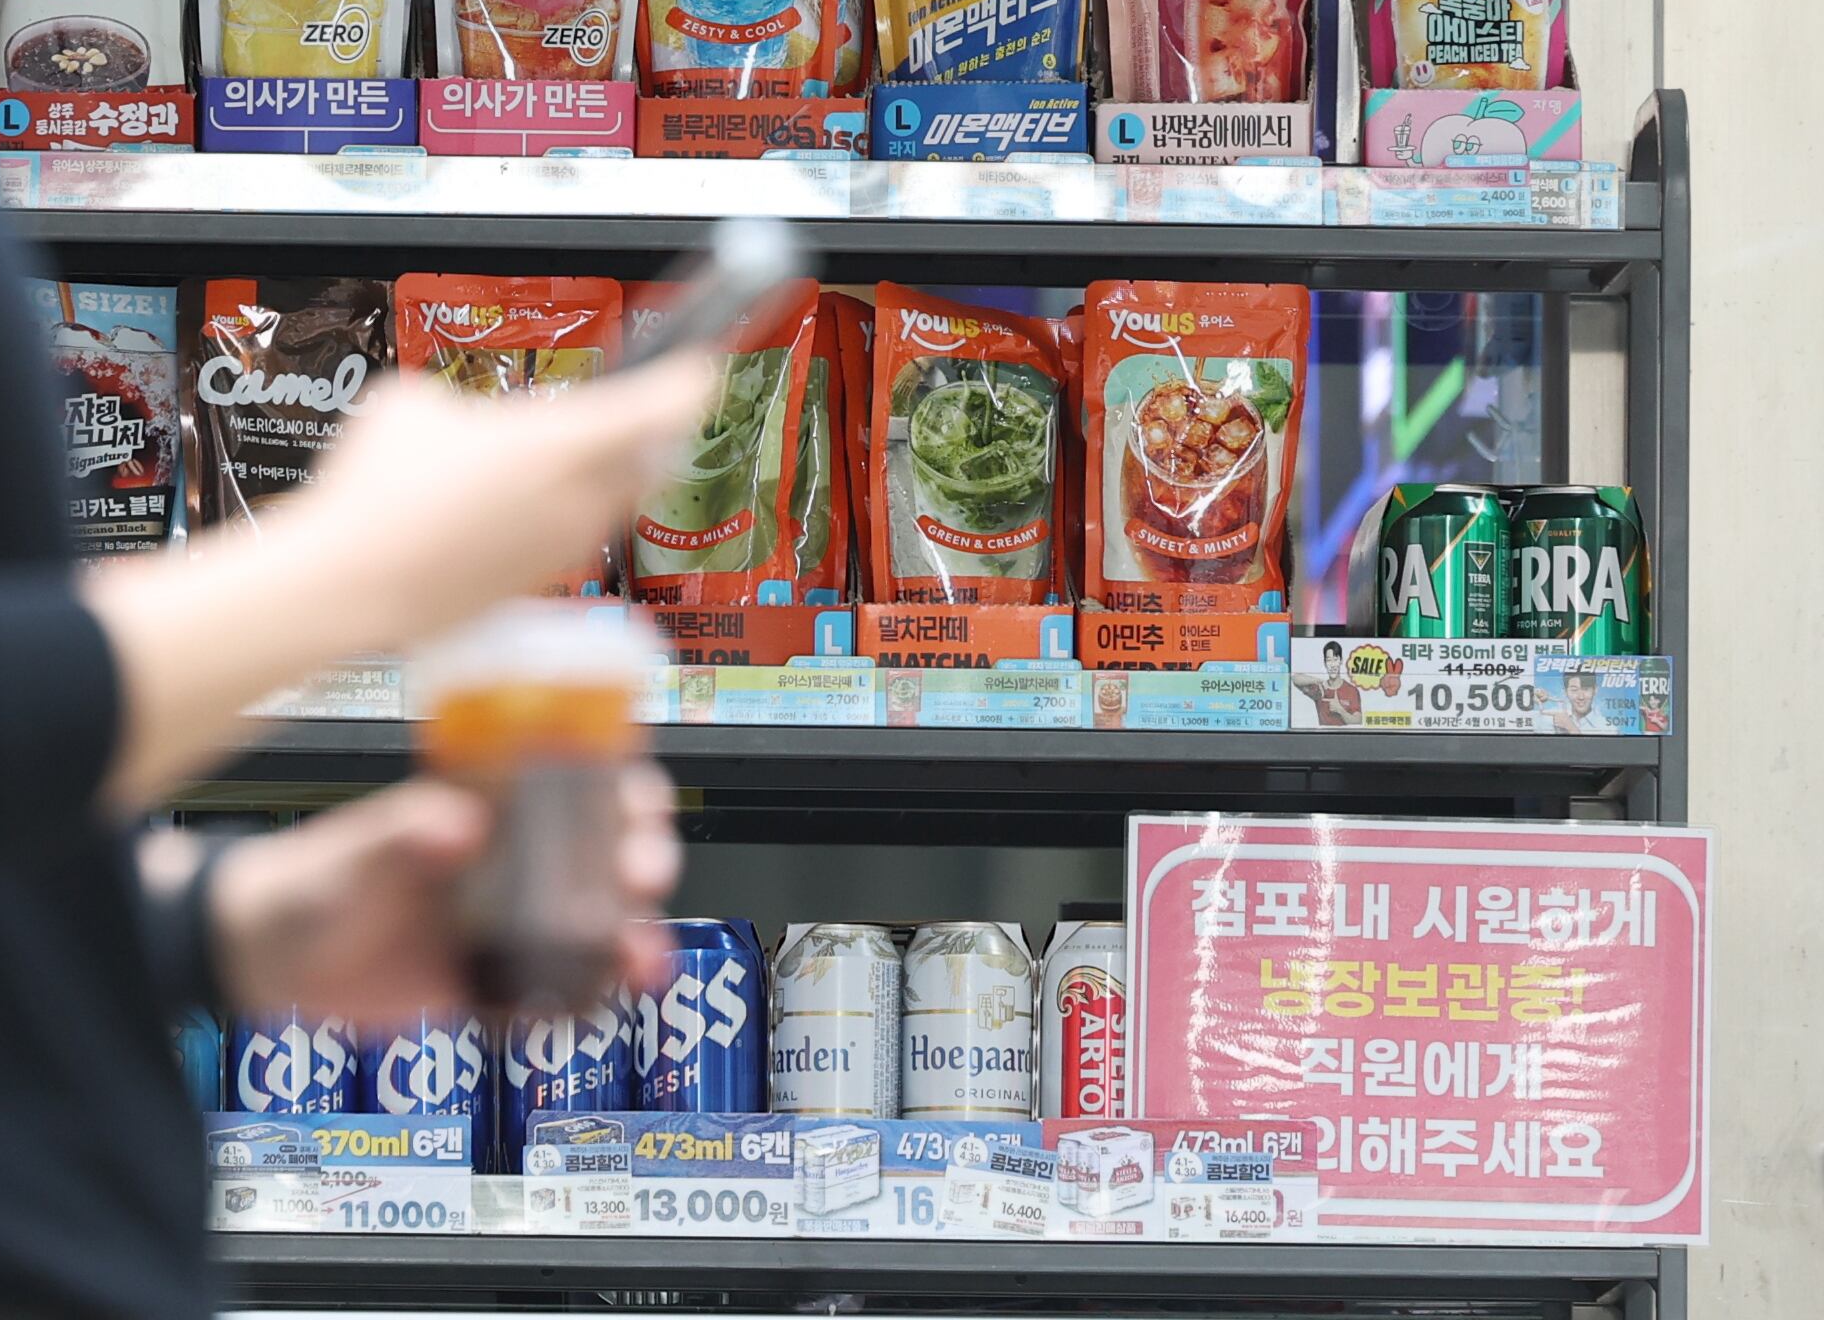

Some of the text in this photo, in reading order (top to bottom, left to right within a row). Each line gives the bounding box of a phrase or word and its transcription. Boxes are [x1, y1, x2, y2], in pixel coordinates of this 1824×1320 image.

[304, 23, 364, 45] ZERO
[681, 18, 785, 40] ZESTY & COOL
[1427, 14, 1523, 44] 아이스티
[1427, 43, 1523, 64] PEACH ICED TEA
[224, 79, 390, 115] 의사가 만든
[442, 82, 606, 119] 의사가 만든
[4, 105, 20, 130] L
[48, 102, 179, 137] 상주 수정과
[888, 140, 917, 157] 라지
[1480, 191, 1516, 204] 2,400
[1109, 308, 1235, 339] youus 유어스
[198, 353, 379, 418] Camel
[644, 518, 741, 547] SWEET & MILKY
[927, 524, 1039, 549] GREEN & CREAMY
[1138, 529, 1250, 554] SWEET & MINTY
[879, 615, 968, 643] 말차라떼
[1097, 623, 1221, 652] 아민추 아이스티
[1351, 655, 1384, 675] SALE
[1402, 643, 1433, 660] 테라
[1439, 645, 1496, 660] 360ml
[1501, 645, 1528, 661] 6입
[1601, 673, 1637, 688] 100%
[1238, 699, 1273, 712] 2,200
[1407, 683, 1536, 717] 10,500
[1605, 698, 1636, 710] TERRA
[1605, 716, 1637, 727] SON7
[1333, 882, 1390, 941] 내
[1412, 884, 1657, 947] 시원하게
[1301, 1036, 1543, 1101] 직원에게
[537, 1061, 615, 1109] FRESH
[954, 1088, 1027, 1102] ORIGINAL
[312, 1127, 463, 1160] 370ml 6캔
[635, 1131, 791, 1165] 473ml 6캔
[564, 1154, 628, 1172] 콤보할인
[989, 1152, 1054, 1180] 콤보할인
[1206, 1163, 1271, 1181] 콤보할인
[339, 1200, 466, 1232] 11,000원
[633, 1188, 789, 1226] 13,000원
